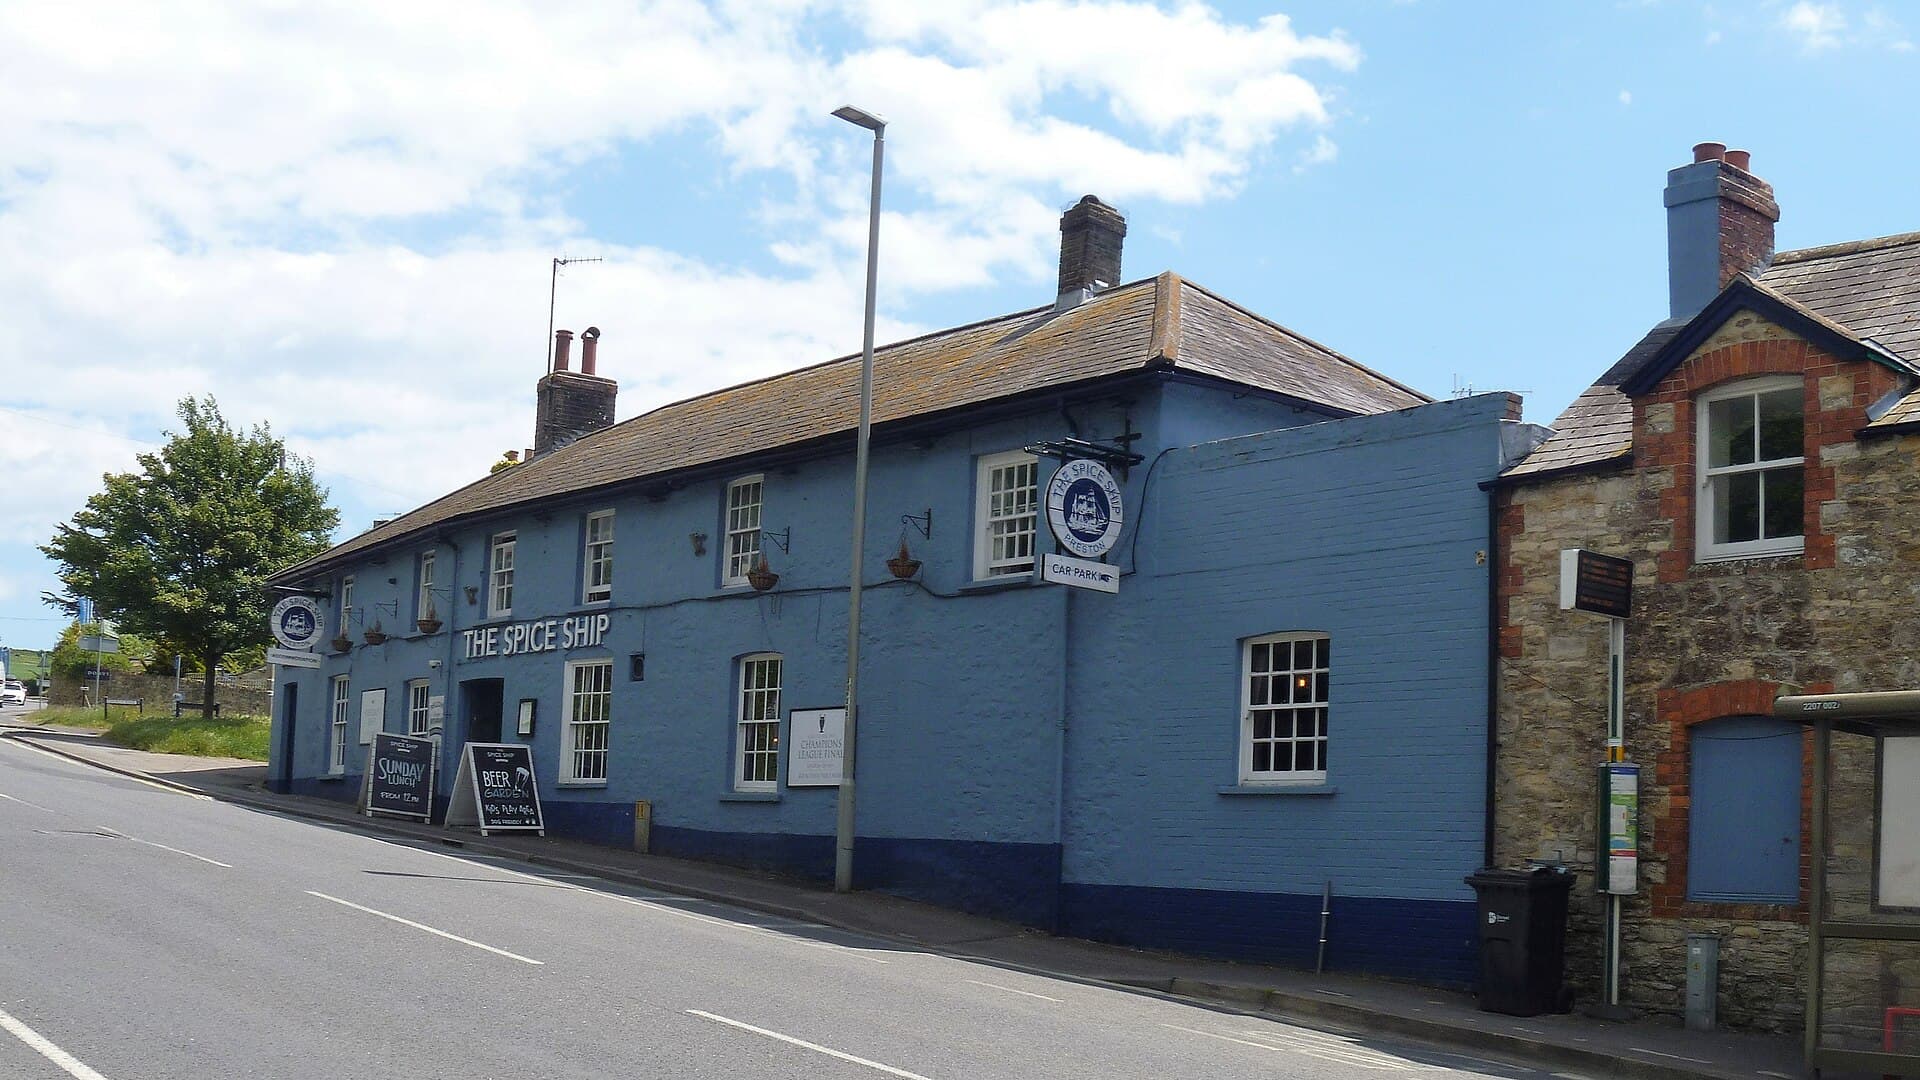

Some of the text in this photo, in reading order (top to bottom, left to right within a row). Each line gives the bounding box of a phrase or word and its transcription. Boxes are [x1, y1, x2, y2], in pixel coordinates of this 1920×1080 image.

[1053, 463, 1121, 516] THE SPICE SHIP
[1064, 534, 1106, 554] PRESTON
[1052, 563, 1097, 581] CAR PARK
[463, 613, 610, 659] THE SPICE SHIP
[482, 770, 511, 788] BEER
[484, 788, 530, 798] GARDEN
[501, 804, 518, 815] PLAY
